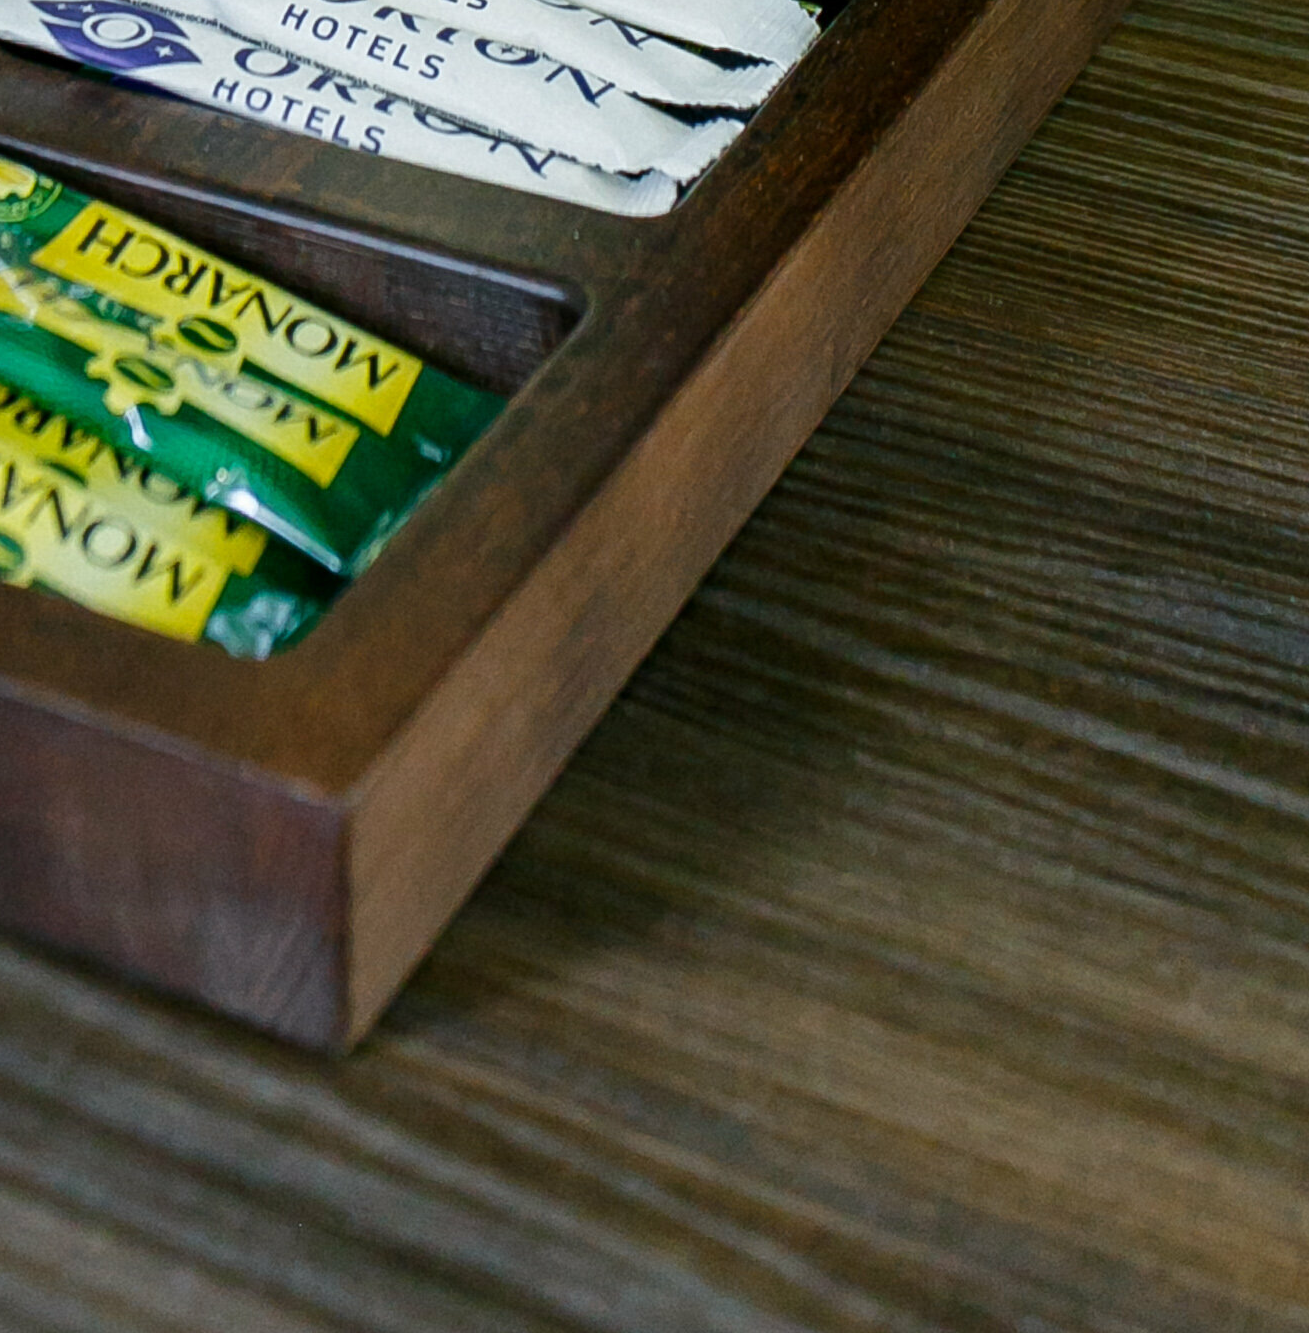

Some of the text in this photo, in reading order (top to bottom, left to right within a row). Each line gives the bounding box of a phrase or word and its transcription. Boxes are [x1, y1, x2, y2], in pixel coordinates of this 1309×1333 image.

[280, 3, 445, 81] HOTELS
[211, 76, 386, 156] HOTELS
[75, 216, 399, 392] MONARCH
